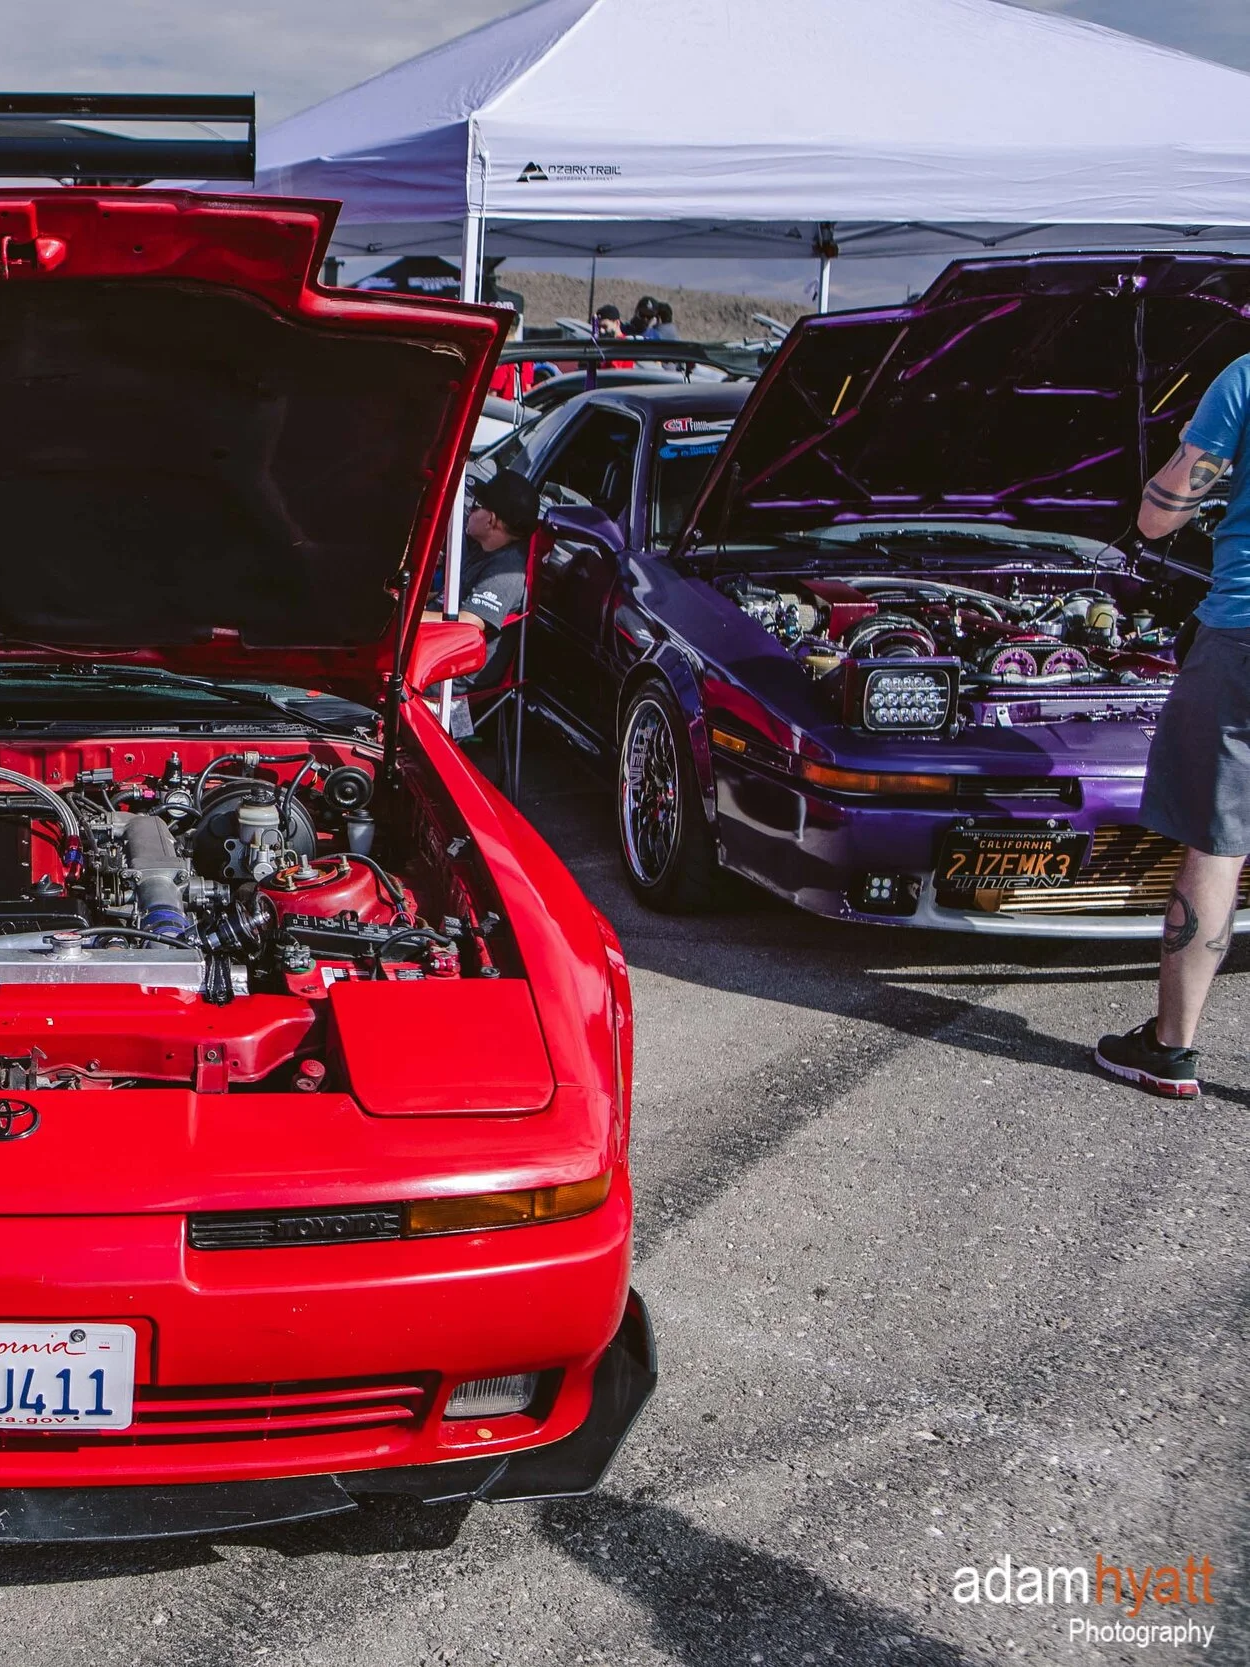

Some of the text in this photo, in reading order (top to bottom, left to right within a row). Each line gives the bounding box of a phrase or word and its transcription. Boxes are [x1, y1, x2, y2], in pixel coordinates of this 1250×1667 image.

[548, 165, 621, 175] OZARK TRAIL
[979, 840, 1052, 850] CALIFORNIA
[279, 1213, 384, 1237] TOYOTA
